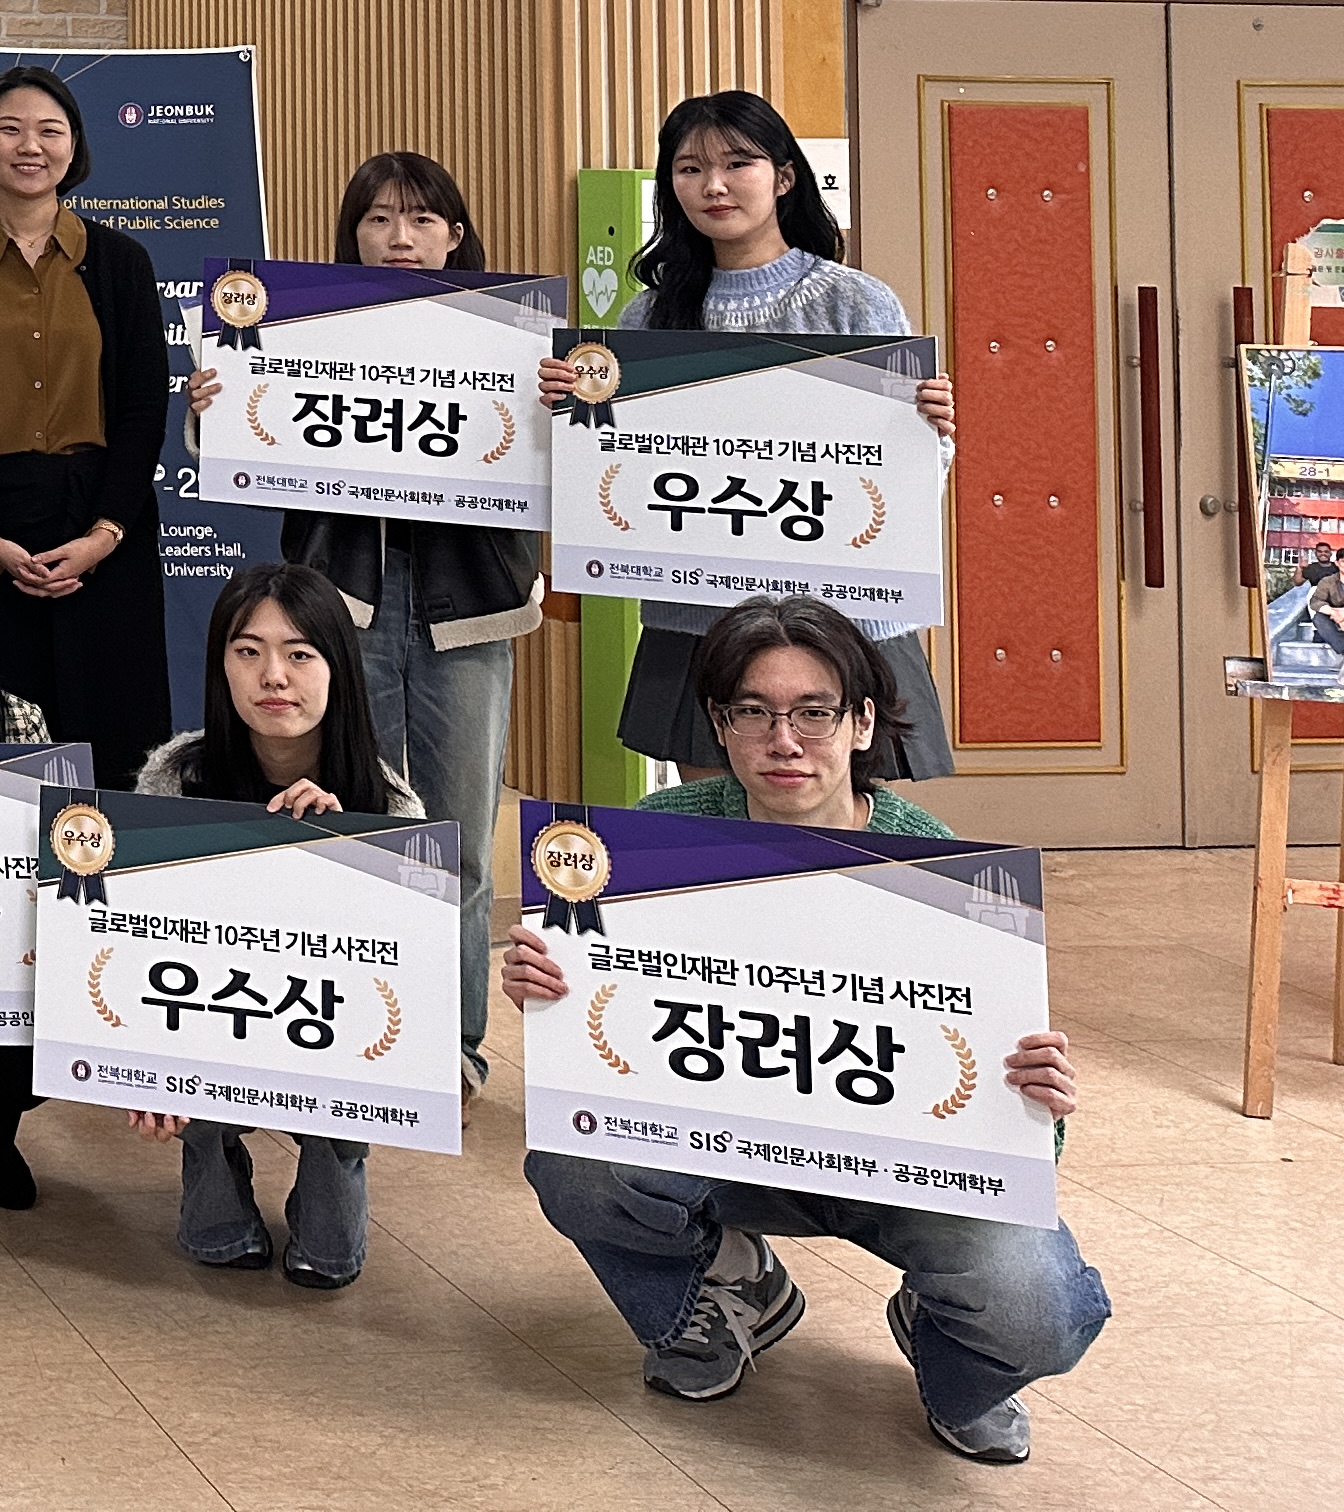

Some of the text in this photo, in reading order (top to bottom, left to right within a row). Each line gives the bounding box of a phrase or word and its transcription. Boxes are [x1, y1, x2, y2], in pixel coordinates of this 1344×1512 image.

[148, 105, 214, 116] JEONBUK
[64, 195, 225, 210] of International Studies
[118, 216, 161, 229] Public
[164, 216, 219, 229] Science
[586, 246, 613, 265] AED
[222, 293, 257, 305] 장려상
[249, 356, 515, 393] 글로벌인재관 10주년 기념 사진전
[574, 364, 609, 380] 우수상
[292, 392, 467, 457] 장려상
[598, 432, 883, 466] 글로벌인재관 10주년 기념 사진전
[1299, 467, 1330, 477] 28-1
[256, 475, 308, 489] 전북대학교
[647, 472, 832, 542] 우수상
[160, 523, 217, 539] Lounge,
[158, 542, 245, 559] Leaders Hall,
[164, 563, 233, 579] University
[609, 563, 663, 579] 전북대학교
[62, 830, 102, 848] 우수상
[547, 849, 595, 871] 장려상
[89, 908, 399, 966] 글로벌인재관 10주년 기념 사진전
[587, 943, 973, 1015] 글로벌인재관 10주년 기념 사진전
[141, 961, 345, 1049] 우수상
[652, 997, 905, 1106] 장려상
[97, 1064, 157, 1085] 전북대학교
[604, 1115, 679, 1141] 전북대학교
